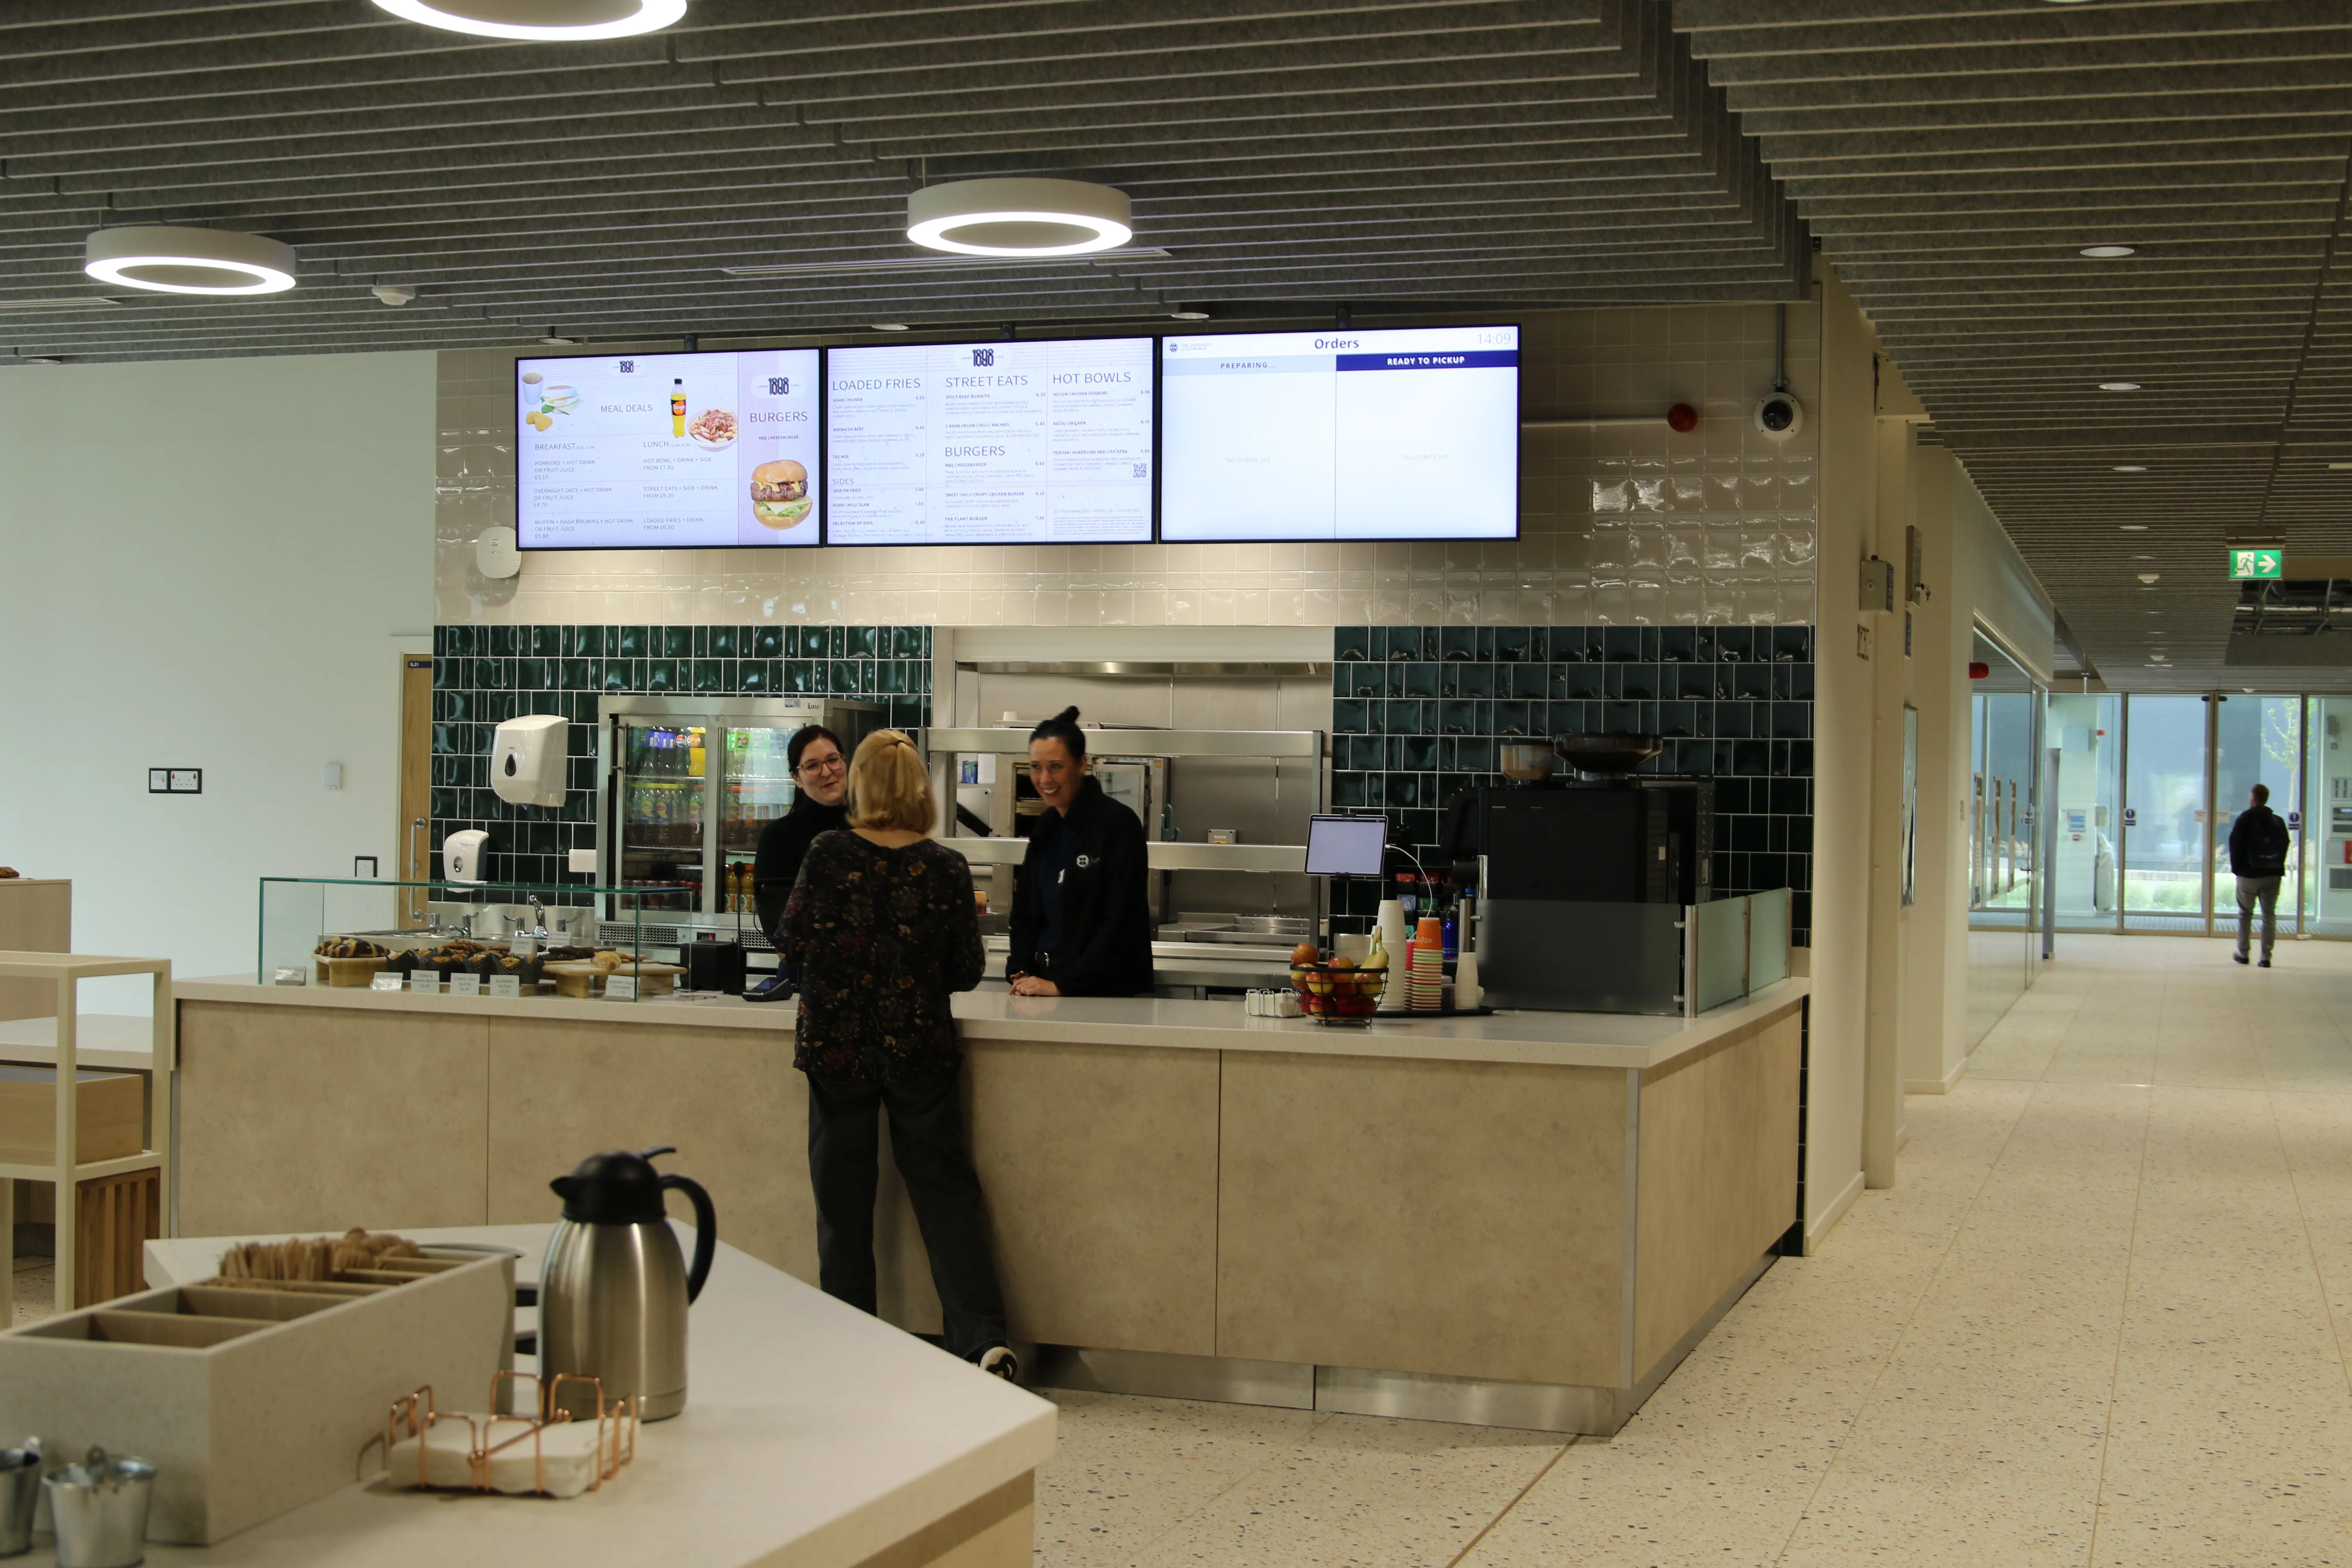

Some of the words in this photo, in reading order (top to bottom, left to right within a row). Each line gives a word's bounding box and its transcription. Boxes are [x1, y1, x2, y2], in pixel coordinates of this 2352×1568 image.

[1315, 338, 1359, 349] Orders
[1478, 333, 1510, 344] 14:09
[972, 349, 994, 367] 1898
[1387, 357, 1415, 366] READY
[1418, 357, 1430, 365] TO
[1433, 355, 1465, 365] PICKUP
[619, 360, 634, 373] 1898
[946, 377, 993, 387] STREET
[998, 376, 1027, 386] EATS
[1054, 374, 1080, 383] HOT
[1085, 372, 1130, 383] BOWLS
[768, 377, 789, 395] 1898
[833, 380, 882, 390] LOADED
[886, 378, 920, 389] FRIES
[750, 412, 807, 422] BURGERS
[946, 446, 1005, 456] BURGERS
